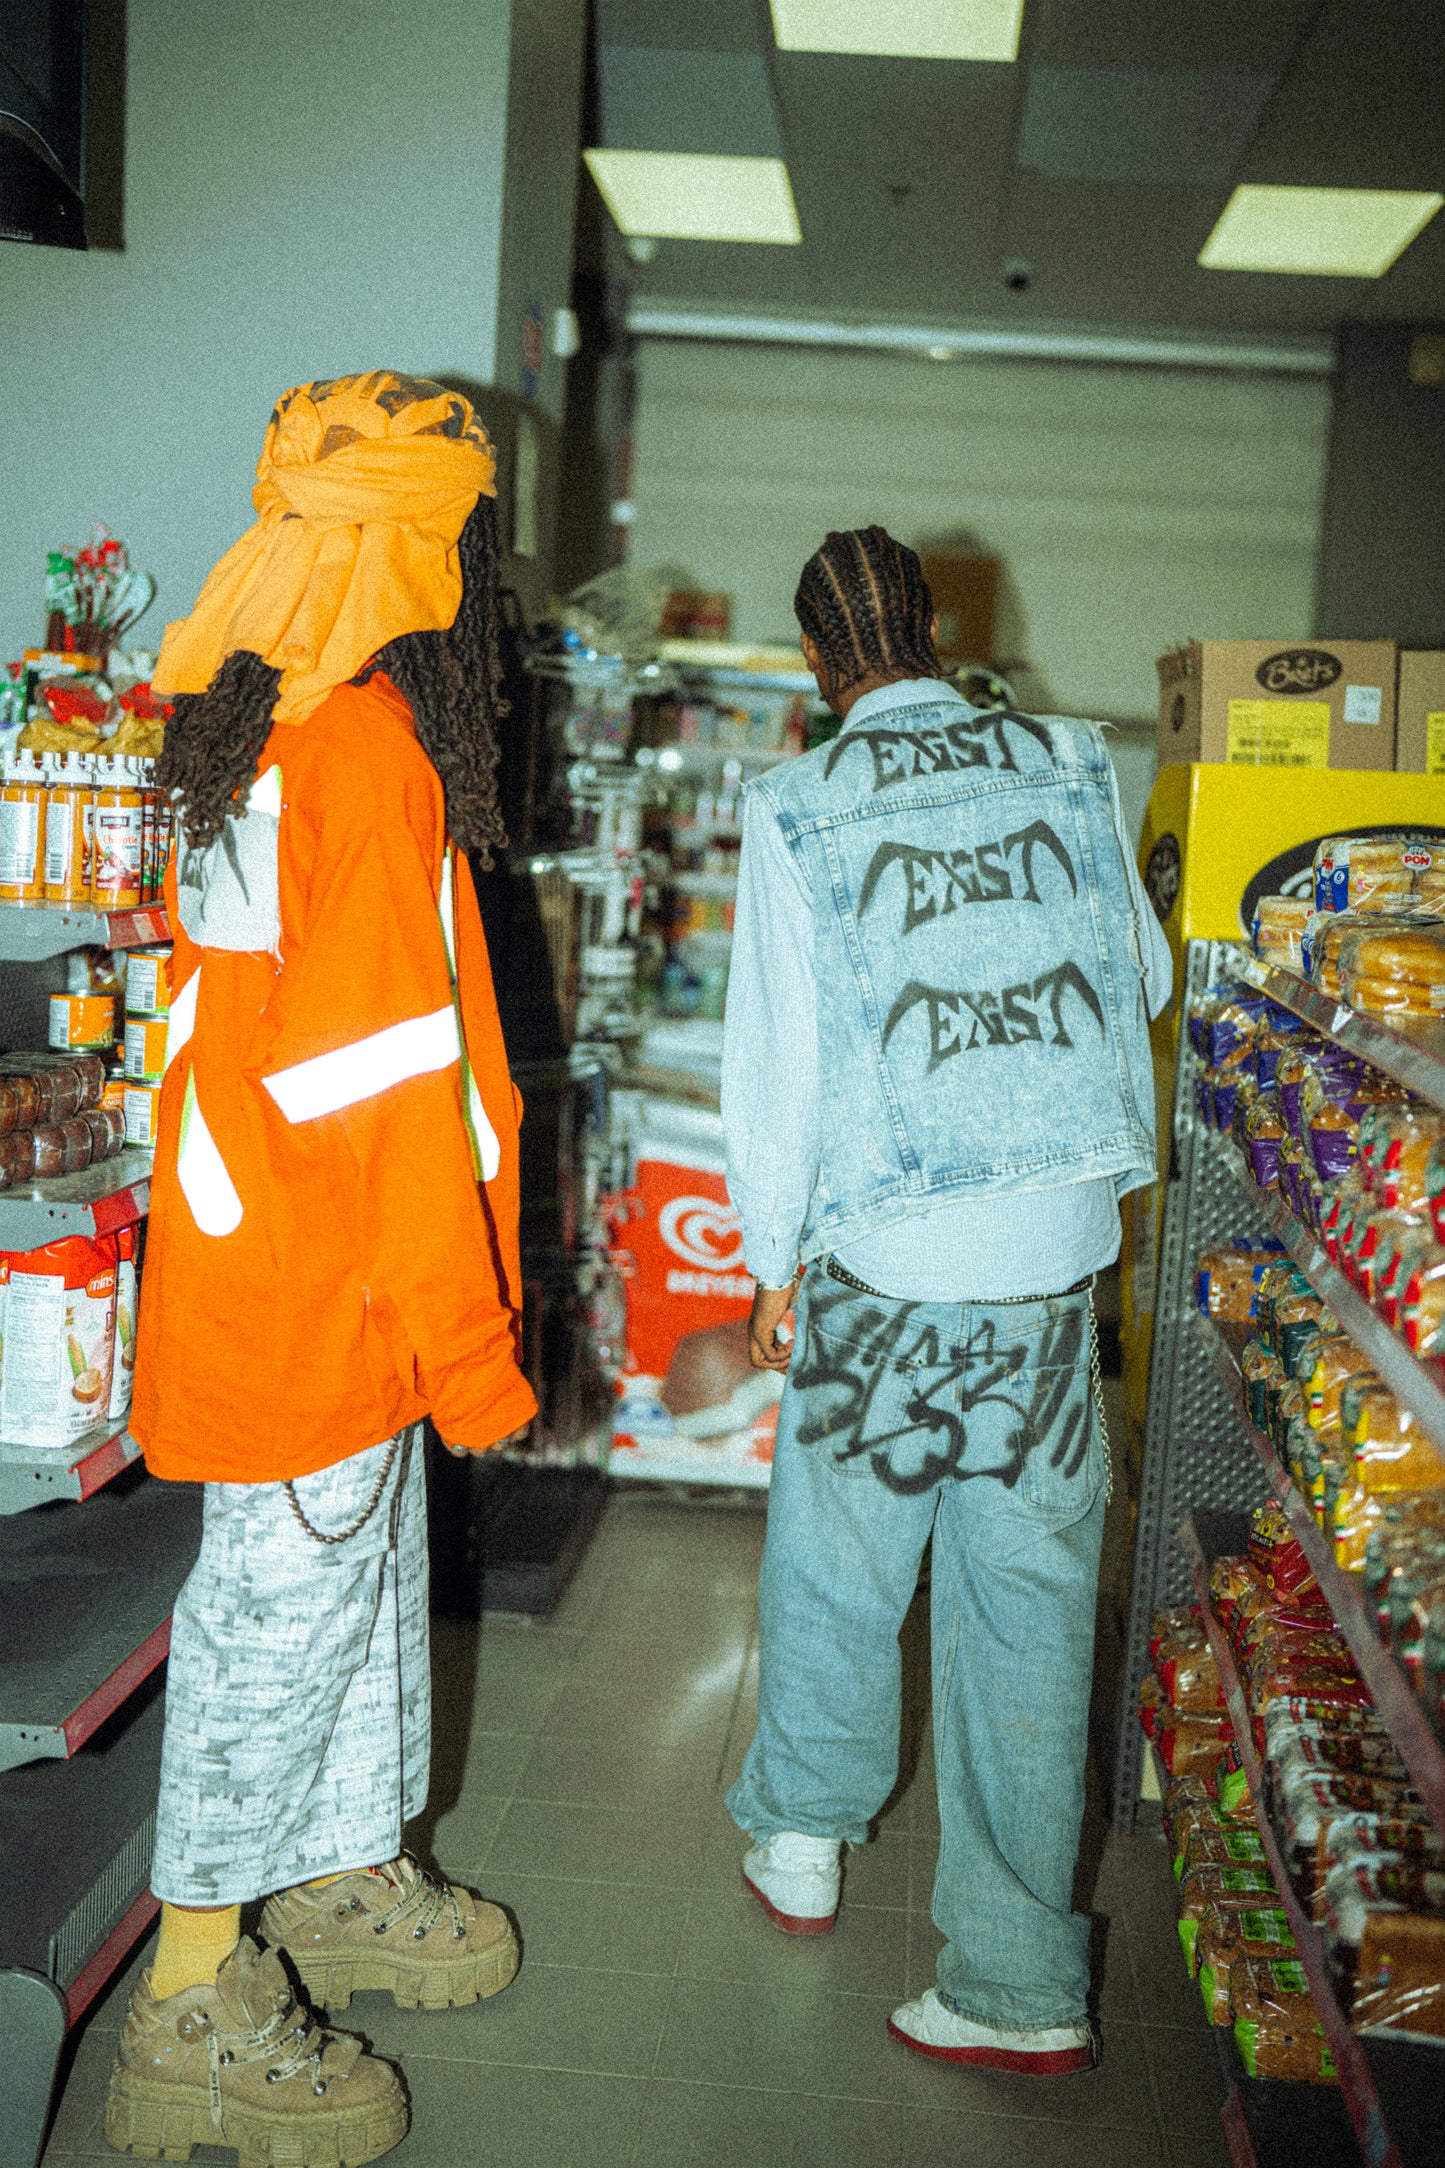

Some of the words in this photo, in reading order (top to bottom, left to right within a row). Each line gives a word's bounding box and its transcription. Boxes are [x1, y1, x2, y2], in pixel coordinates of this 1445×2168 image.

[824, 712, 1056, 792] EXIST
[102, 835, 138, 846] Chotle
[857, 818, 1078, 936] EXIST
[1404, 855, 1430, 866] POM
[881, 960, 1106, 1075] EXIST
